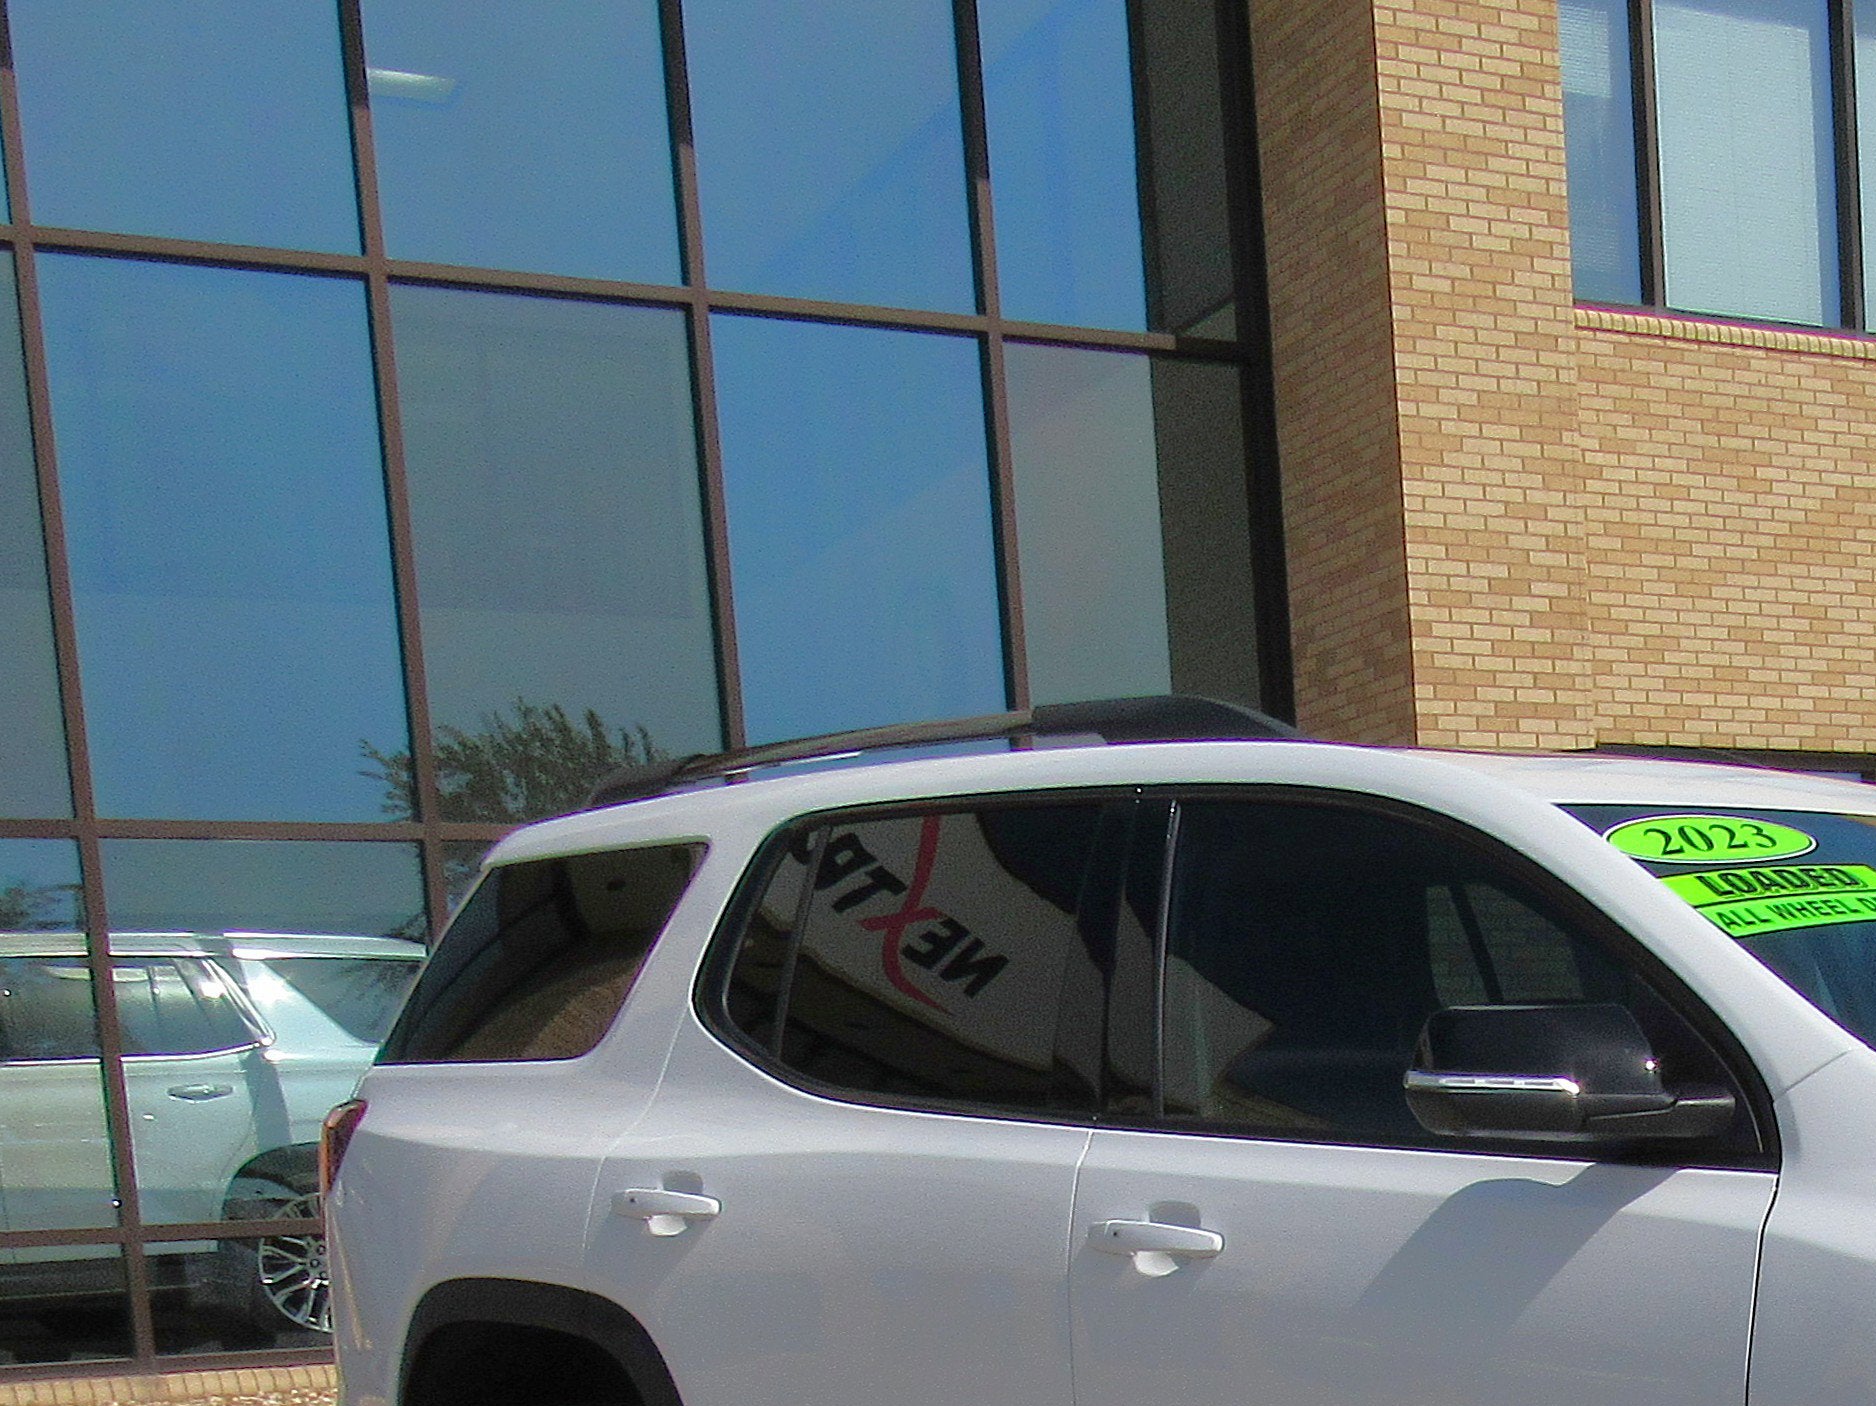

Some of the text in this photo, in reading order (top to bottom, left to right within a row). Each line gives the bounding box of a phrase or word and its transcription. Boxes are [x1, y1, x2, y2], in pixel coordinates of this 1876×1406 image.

[1643, 823, 1779, 857] 2023
[1696, 866, 1867, 898] LOADED
[1715, 906, 1768, 930] ALL
[1768, 897, 1860, 922] WHEEL
